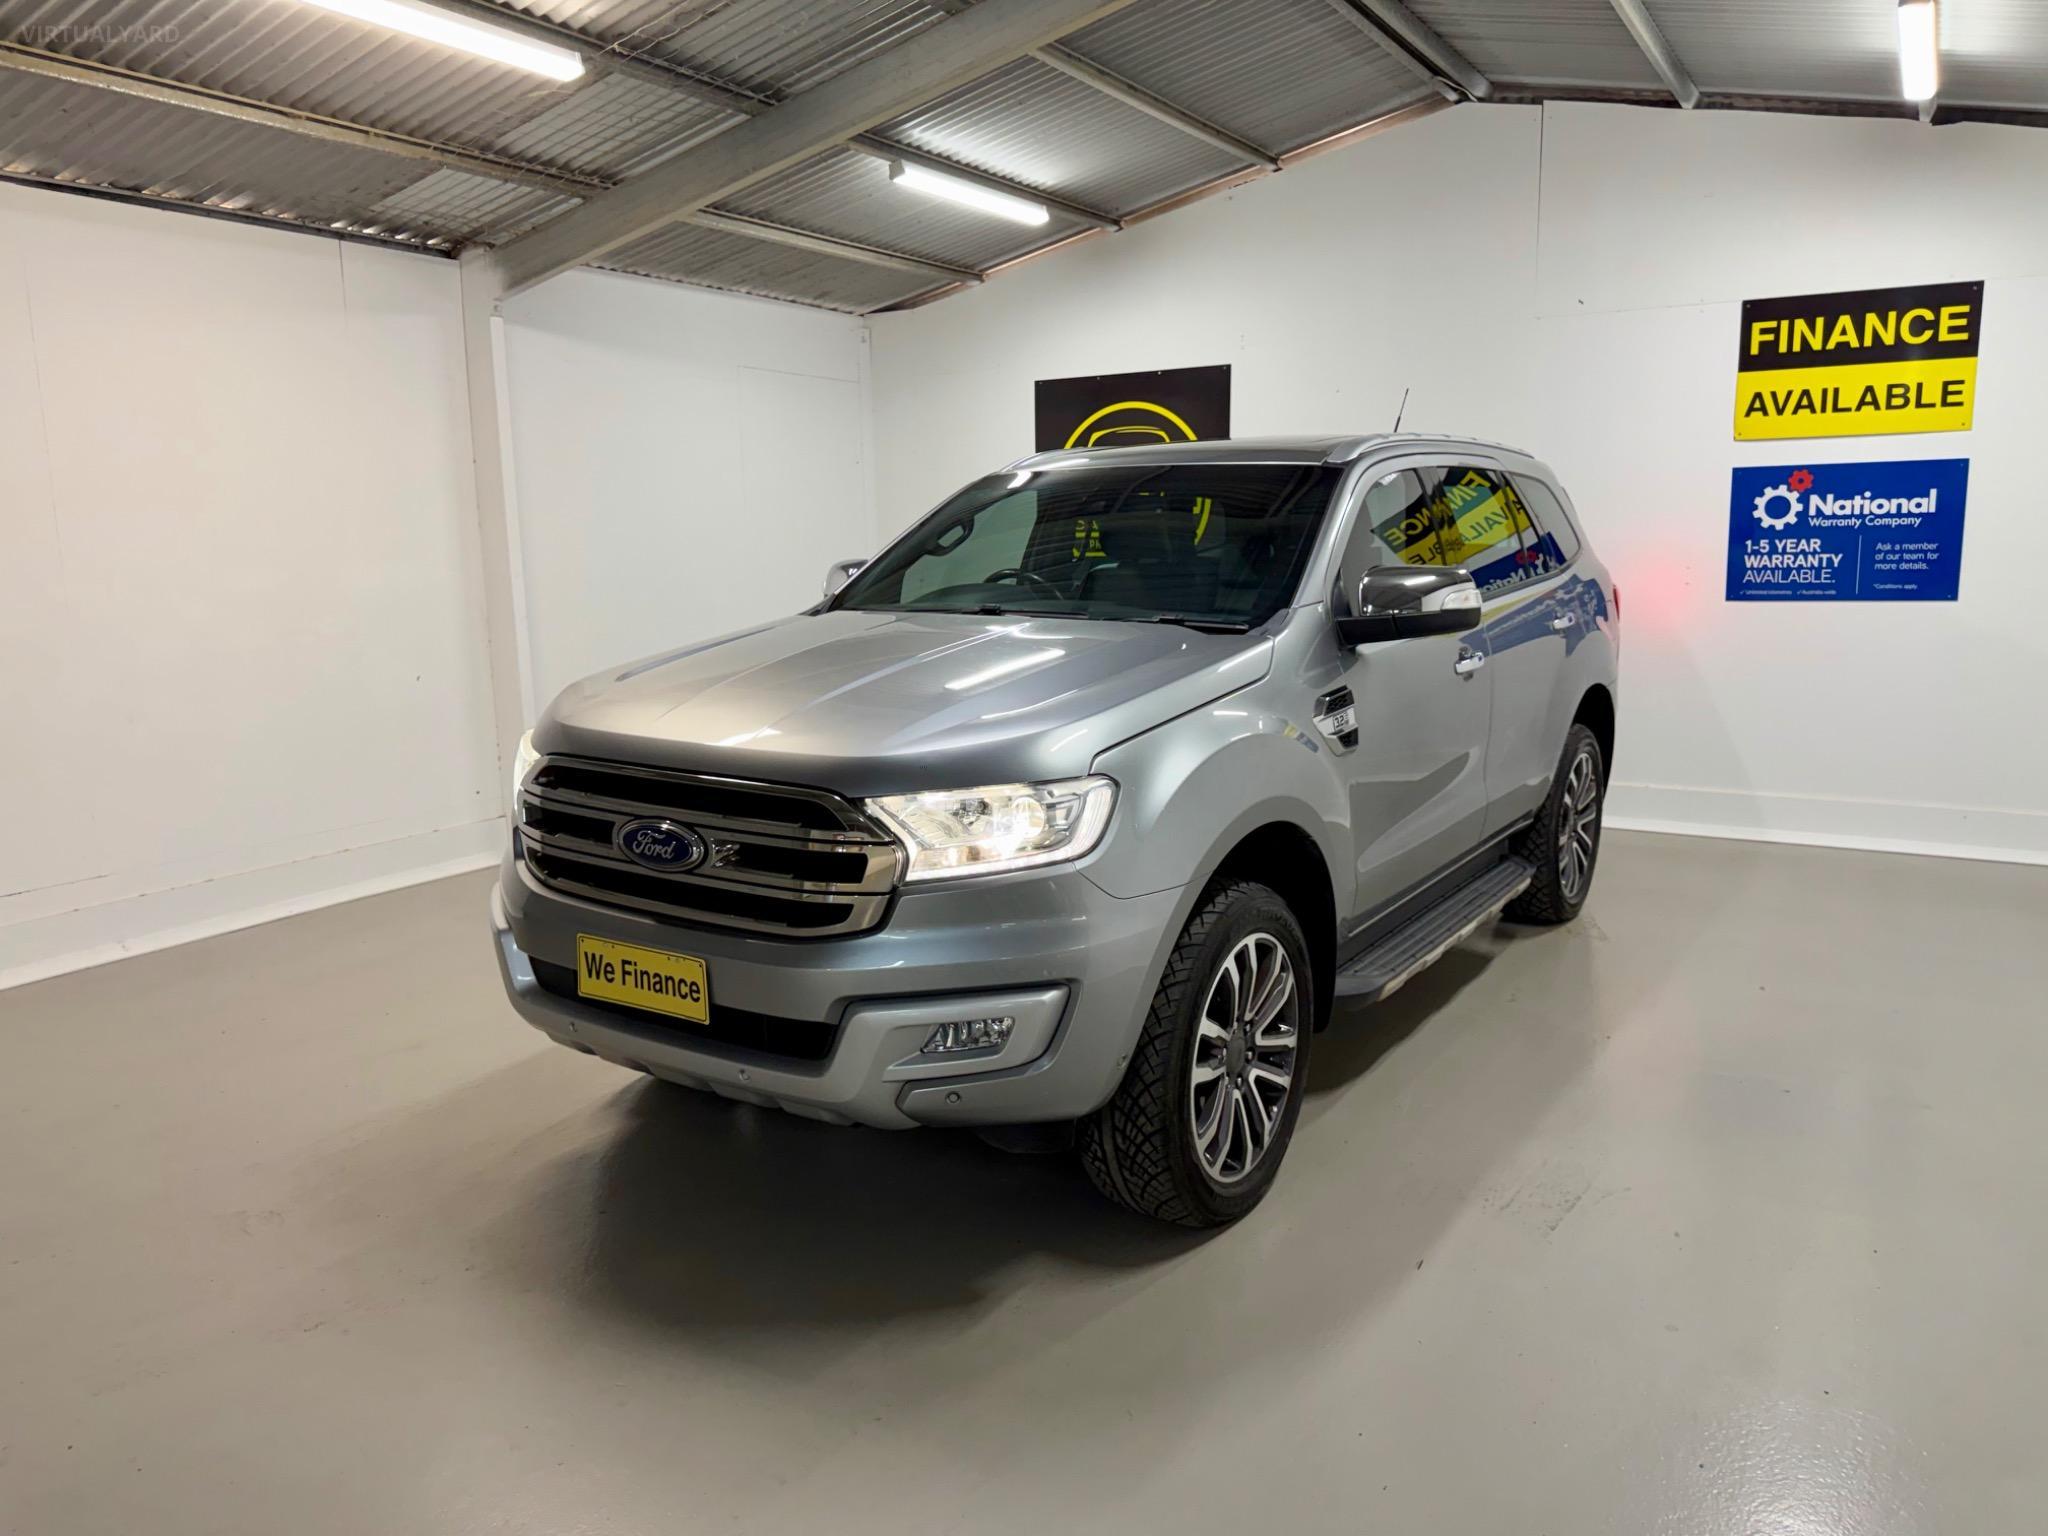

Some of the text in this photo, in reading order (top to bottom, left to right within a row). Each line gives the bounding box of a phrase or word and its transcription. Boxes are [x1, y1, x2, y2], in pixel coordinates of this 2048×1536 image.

[1749, 305, 1971, 356] FINANCE
[1743, 379, 1966, 418] AVAILABLE
[1808, 488, 1938, 517] National
[1808, 515, 1923, 529] Warranty Company
[1745, 538, 1822, 553] 1-5 YEAR
[1875, 542, 1939, 551] Ask a member
[1744, 553, 1843, 569] WARRANTY
[1875, 552, 1940, 561] of our team for
[1874, 563, 1897, 571] more
[1742, 568, 1837, 585] AVAILABLE.
[632, 829, 677, 860] Ford
[584, 951, 701, 1004] We Finance
